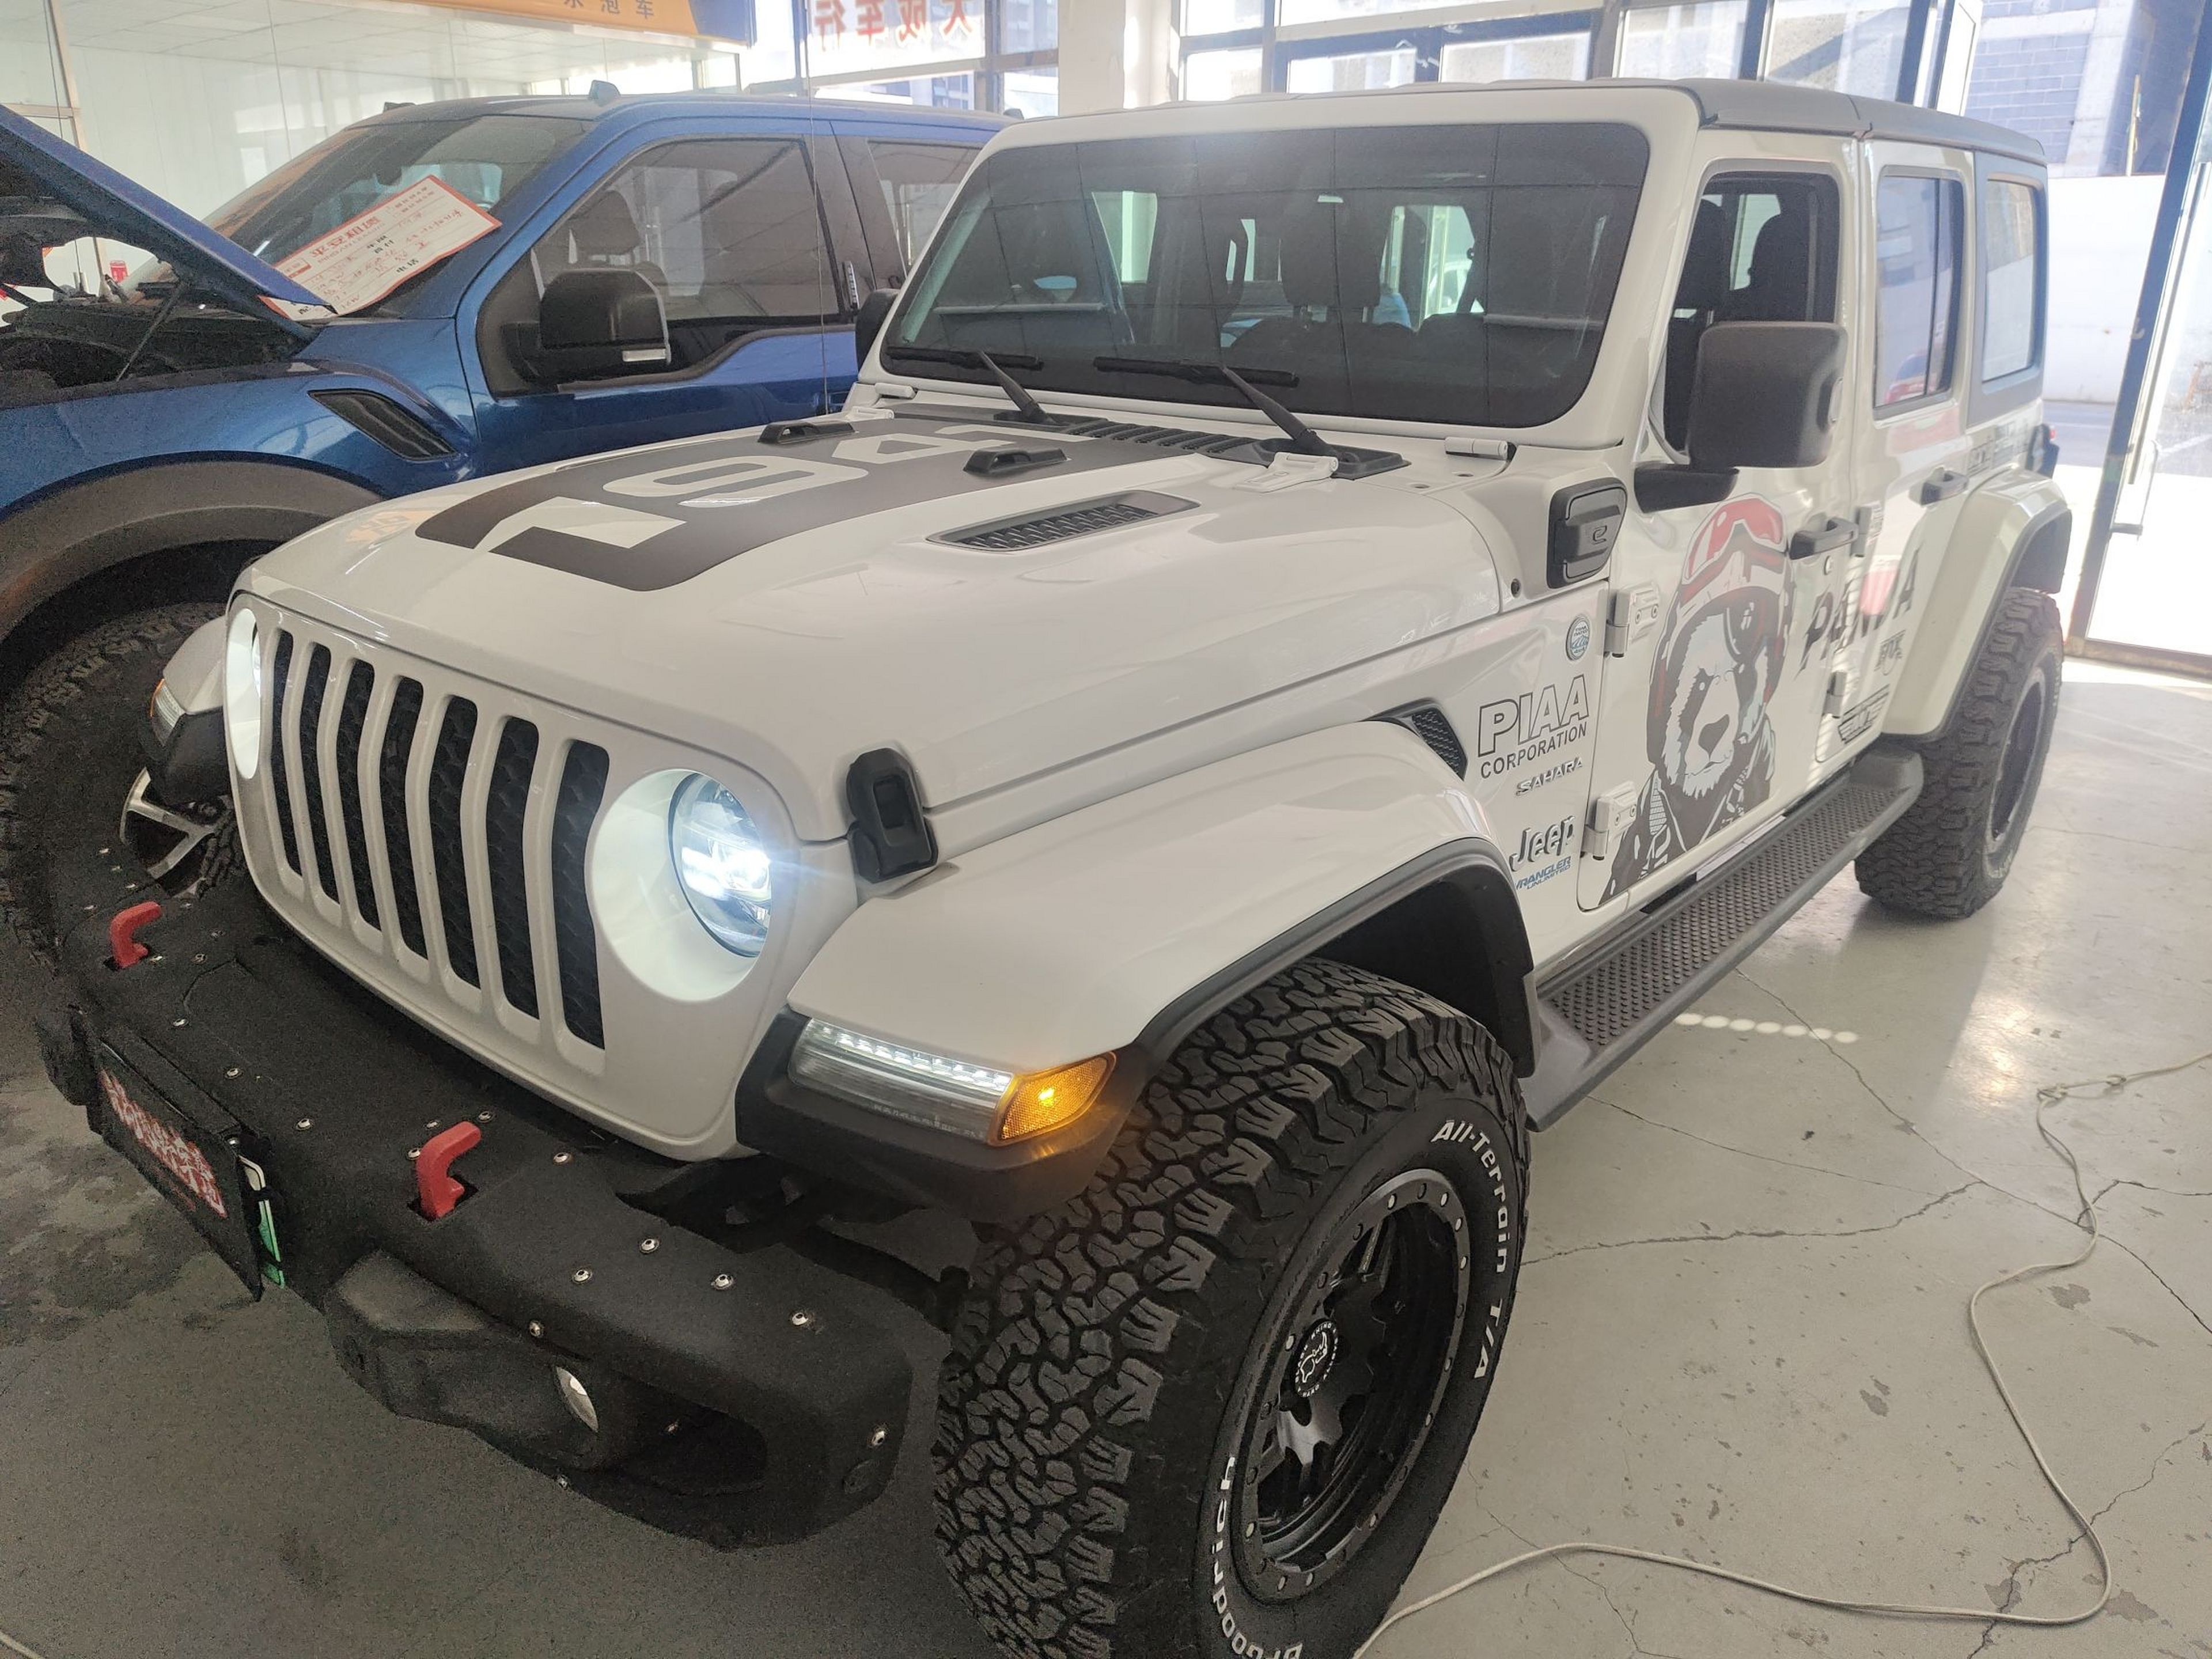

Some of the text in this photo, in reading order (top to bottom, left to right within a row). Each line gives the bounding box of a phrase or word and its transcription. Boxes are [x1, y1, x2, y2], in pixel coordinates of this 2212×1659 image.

[1478, 674, 1590, 757] PIAA
[1480, 722, 1587, 779] CORPORATION
[1516, 756, 1583, 796] SAHARA
[1509, 815, 1575, 872] Jeep
[1430, 1120, 1510, 1378] All-Terrain T/A
